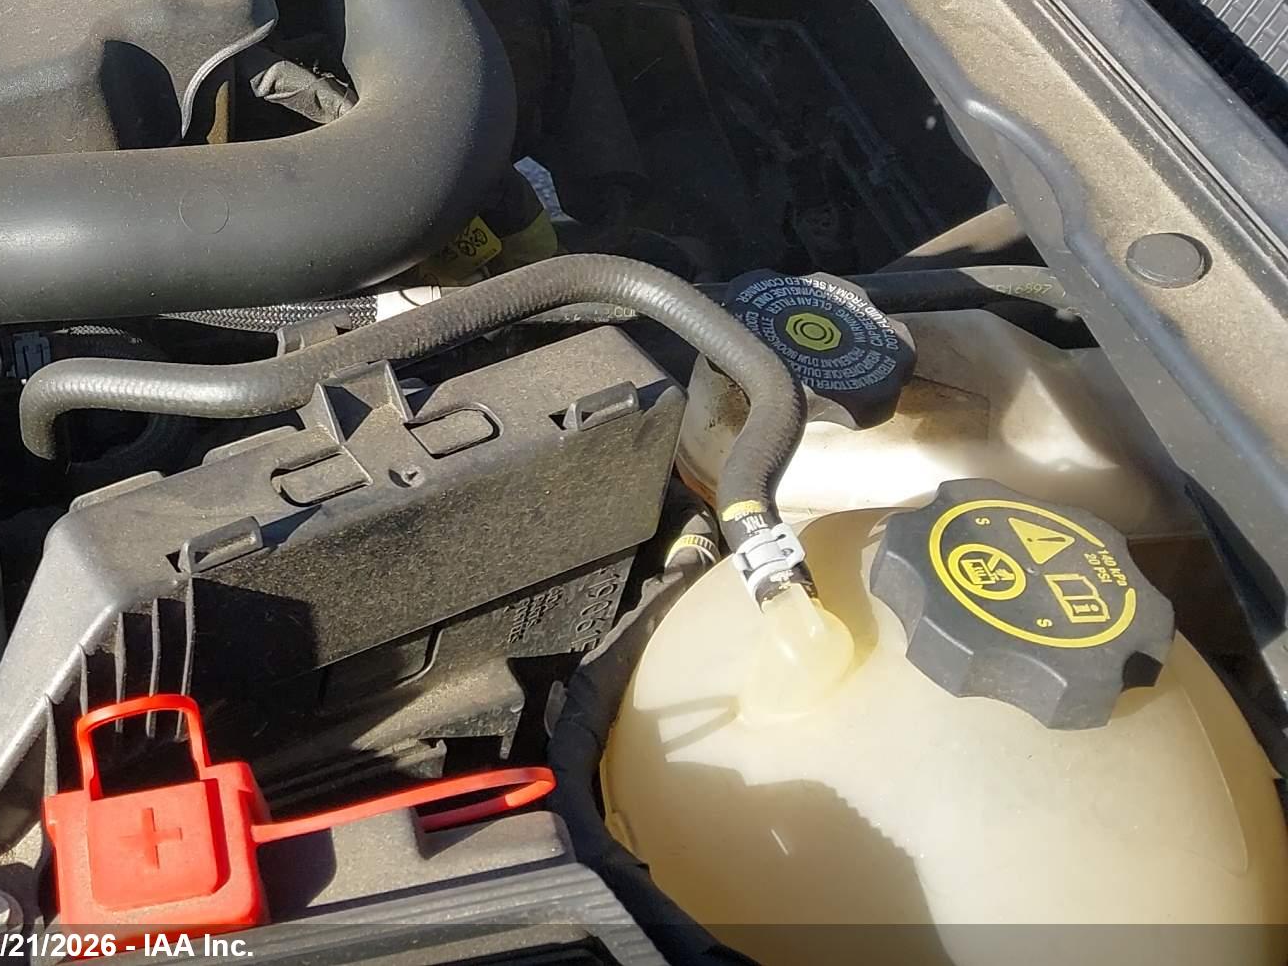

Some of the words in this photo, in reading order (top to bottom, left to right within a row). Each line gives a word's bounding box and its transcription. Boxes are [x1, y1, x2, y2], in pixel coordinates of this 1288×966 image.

[784, 276, 828, 292] SEALED
[828, 283, 837, 294] A
[765, 296, 797, 315] FILLER
[797, 297, 833, 311] CLEAN
[835, 287, 868, 308] FROM
[864, 306, 891, 328] FLUID
[1083, 552, 1102, 569] 20
[1092, 564, 1113, 584] PSI
